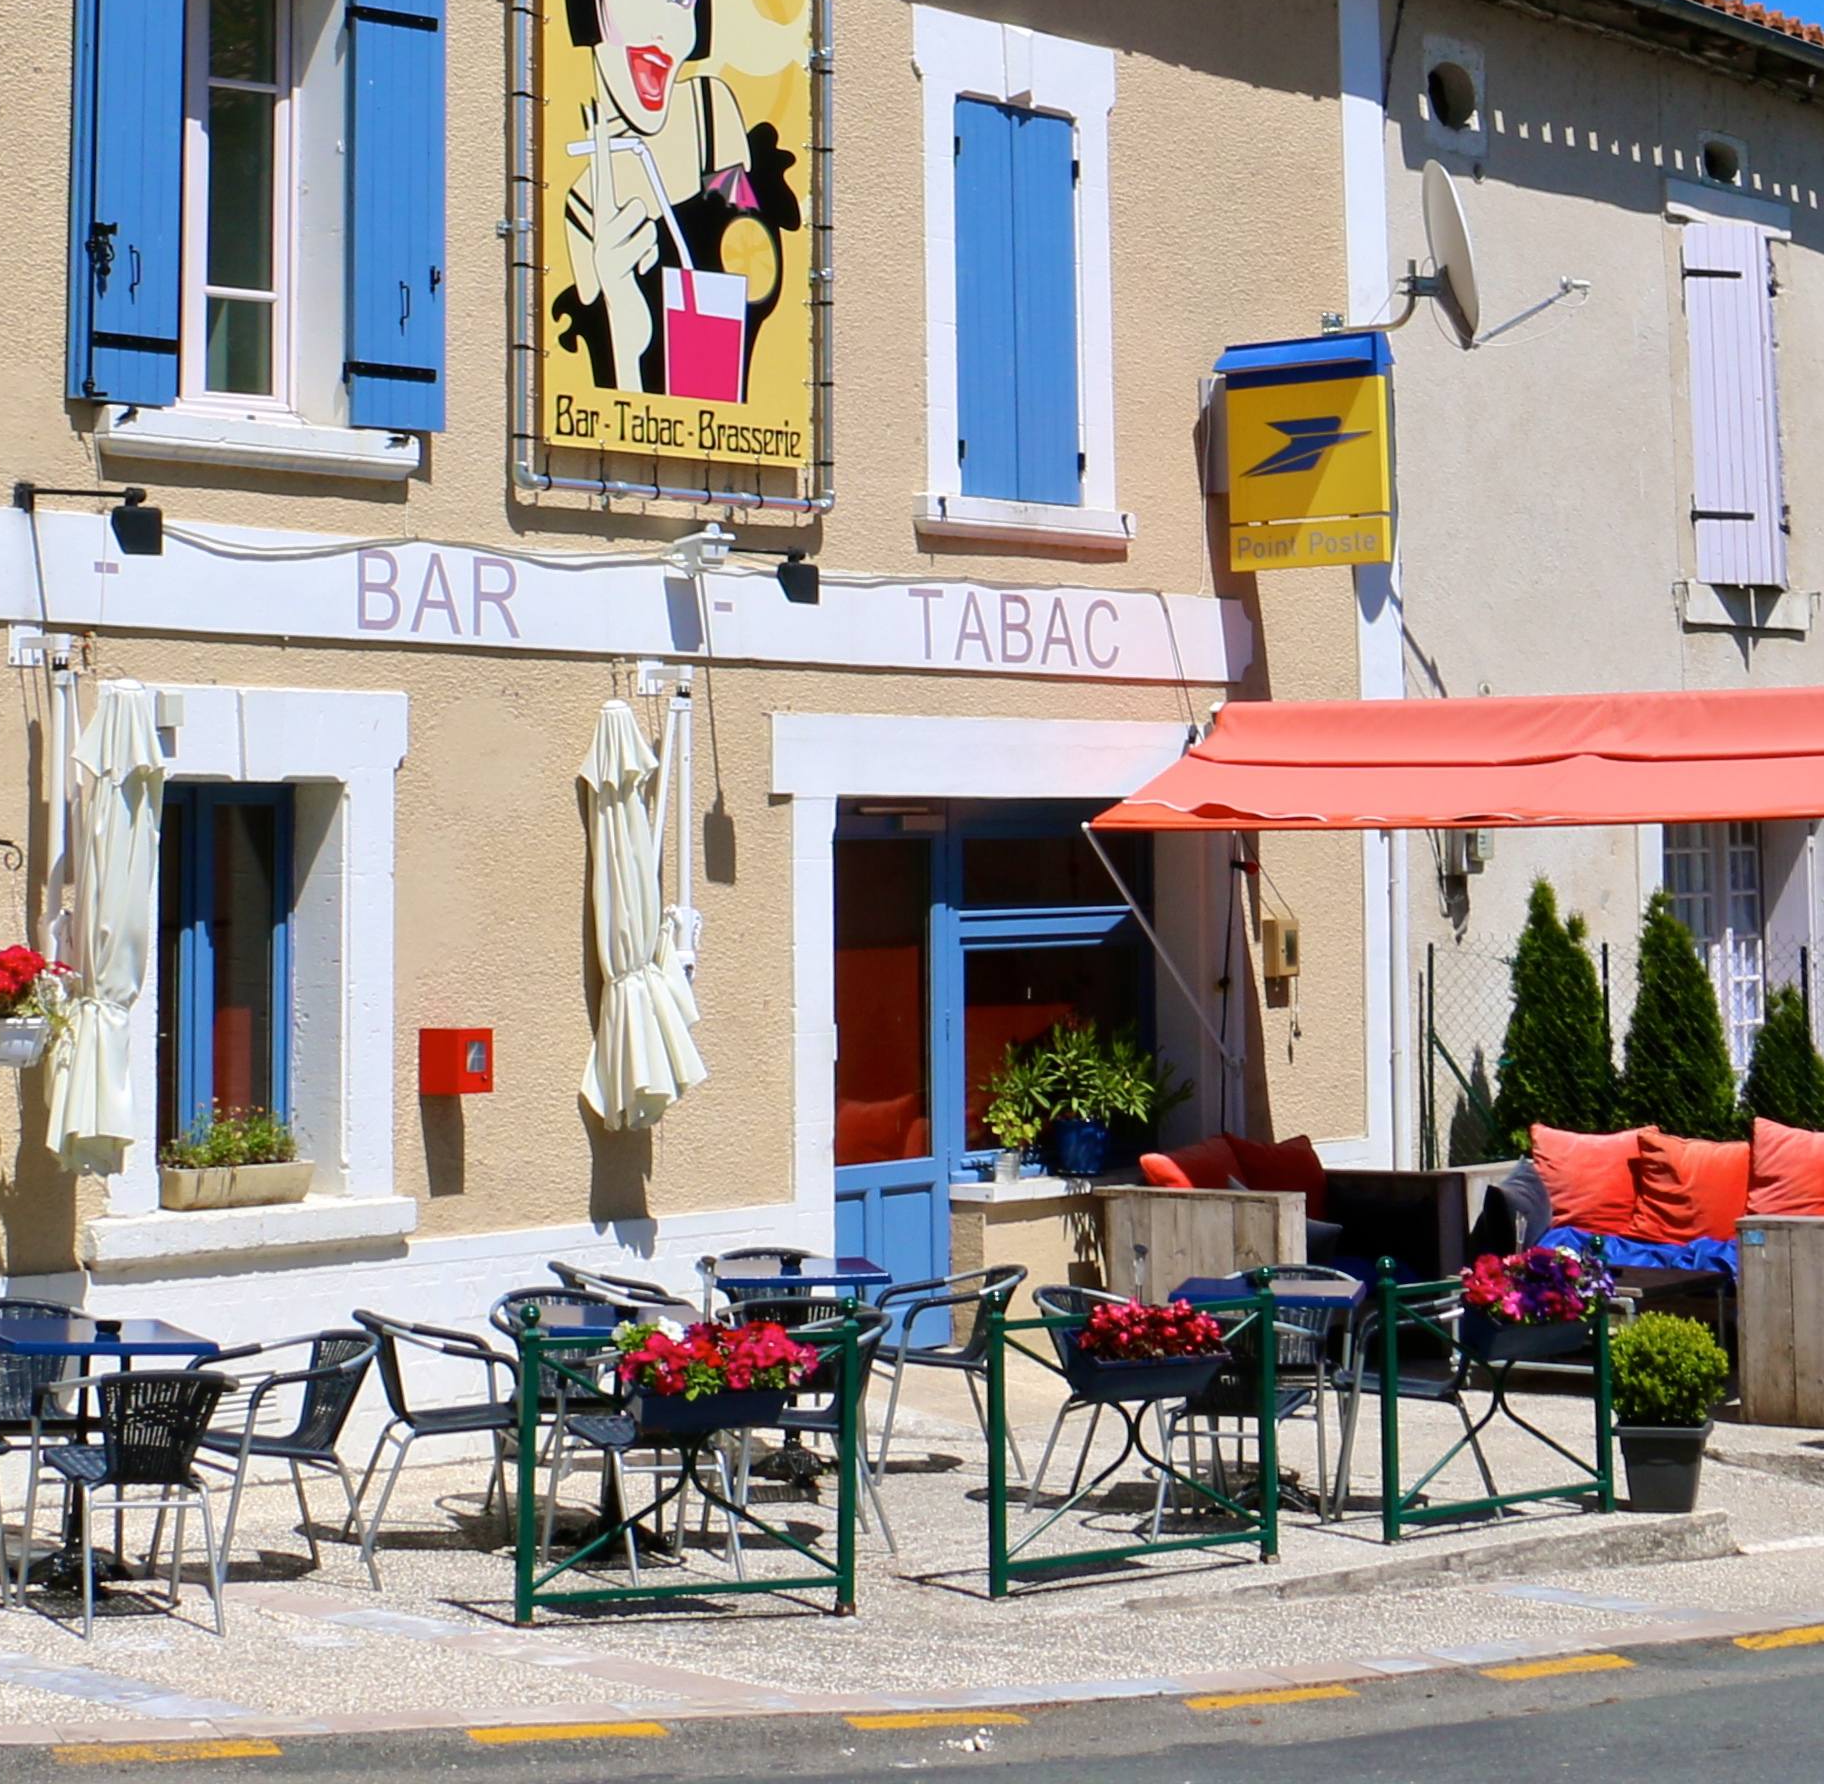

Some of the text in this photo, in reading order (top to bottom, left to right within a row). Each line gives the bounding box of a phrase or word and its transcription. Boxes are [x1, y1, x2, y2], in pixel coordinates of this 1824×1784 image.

[555, 394, 600, 438] Bar
[614, 400, 685, 448] Tabac
[698, 409, 802, 458] Brasserie
[1237, 530, 1377, 561] Point Poste
[357, 548, 521, 639] BAR
[907, 587, 1120, 670] TABAC
